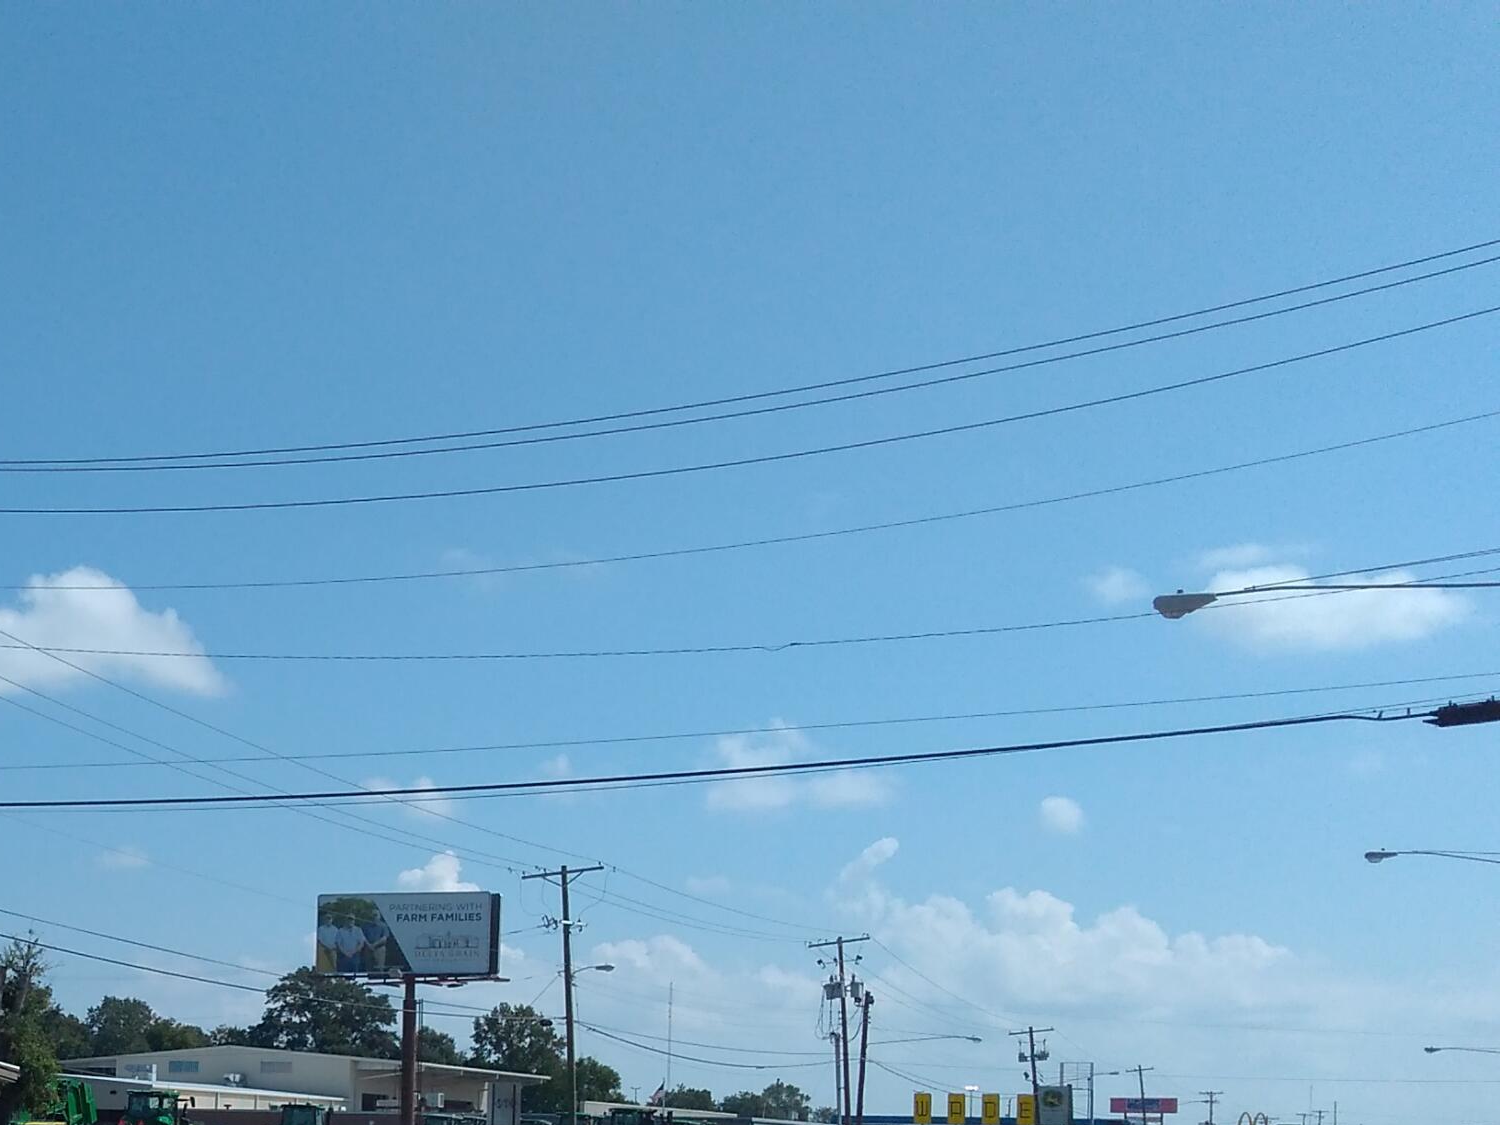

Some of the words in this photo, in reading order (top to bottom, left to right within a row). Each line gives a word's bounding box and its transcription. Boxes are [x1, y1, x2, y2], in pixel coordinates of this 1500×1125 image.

[389, 903, 453, 912] PARTNERING
[456, 902, 483, 910] WITH
[396, 913, 427, 922] FARM
[431, 912, 482, 922] FAMILIES
